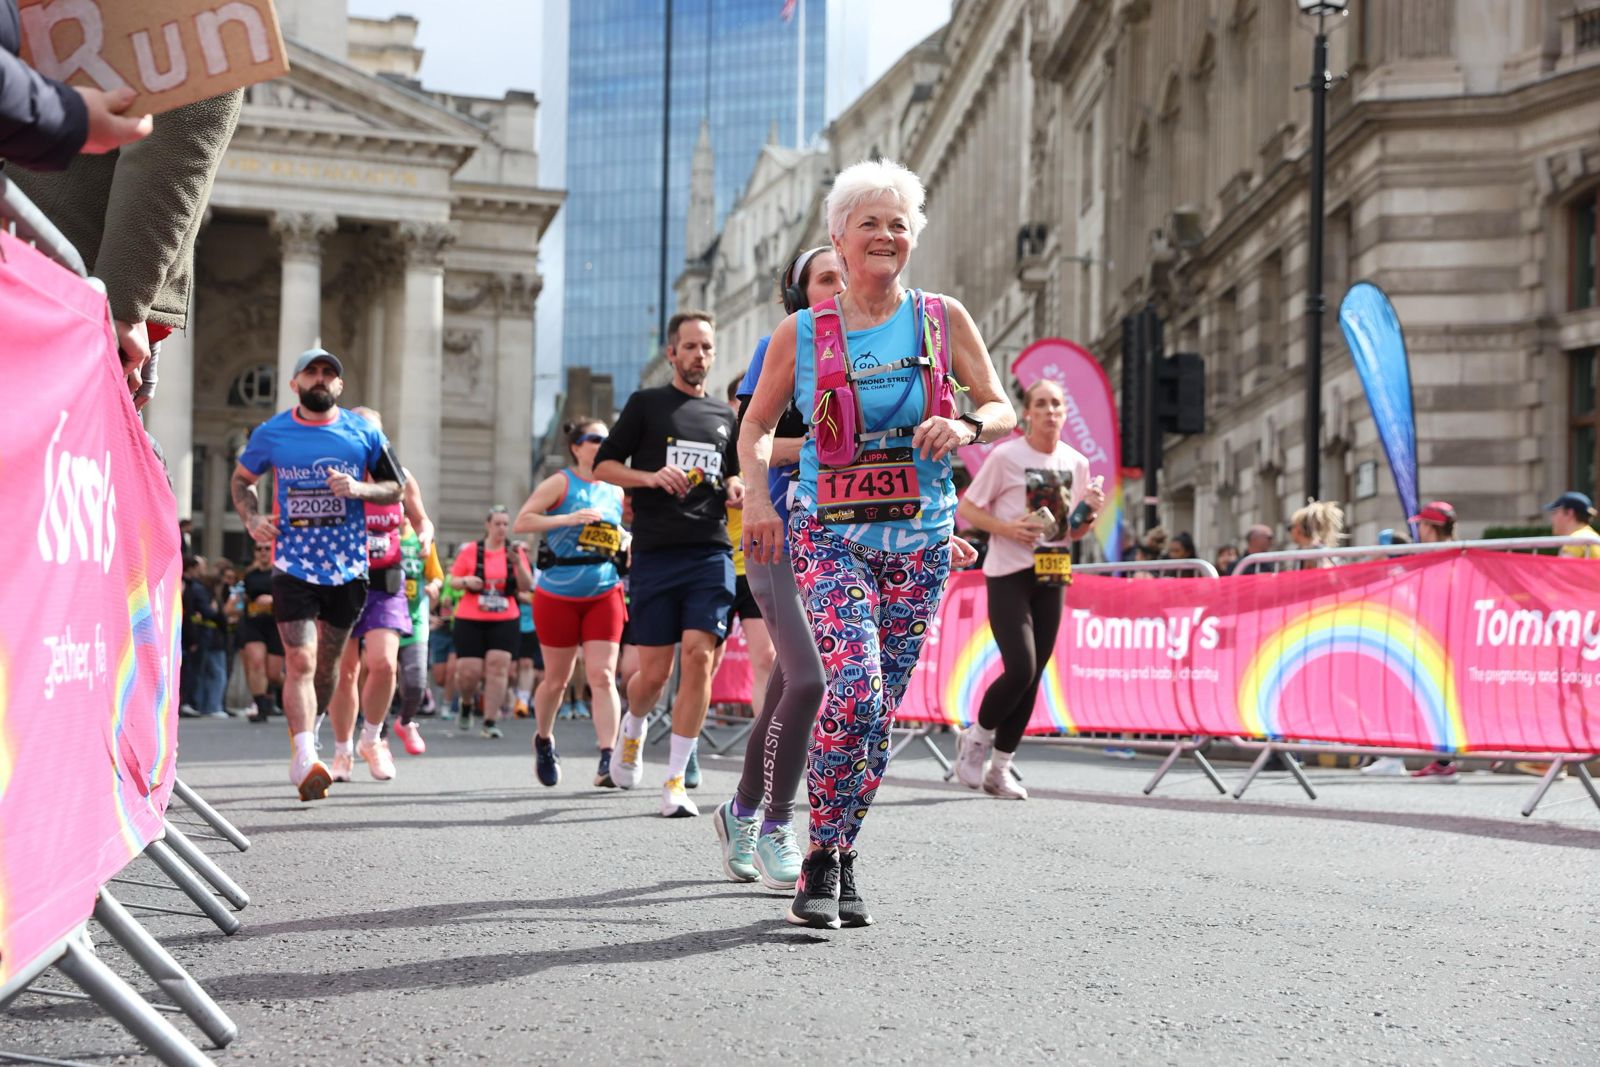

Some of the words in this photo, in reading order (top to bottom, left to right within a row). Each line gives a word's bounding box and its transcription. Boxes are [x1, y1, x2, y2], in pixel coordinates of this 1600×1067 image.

[20, 0, 272, 94] Run
[672, 451, 718, 469] 17714
[826, 469, 909, 499] 17431
[291, 499, 342, 514] 22028
[1072, 607, 1220, 660] Tommy's
